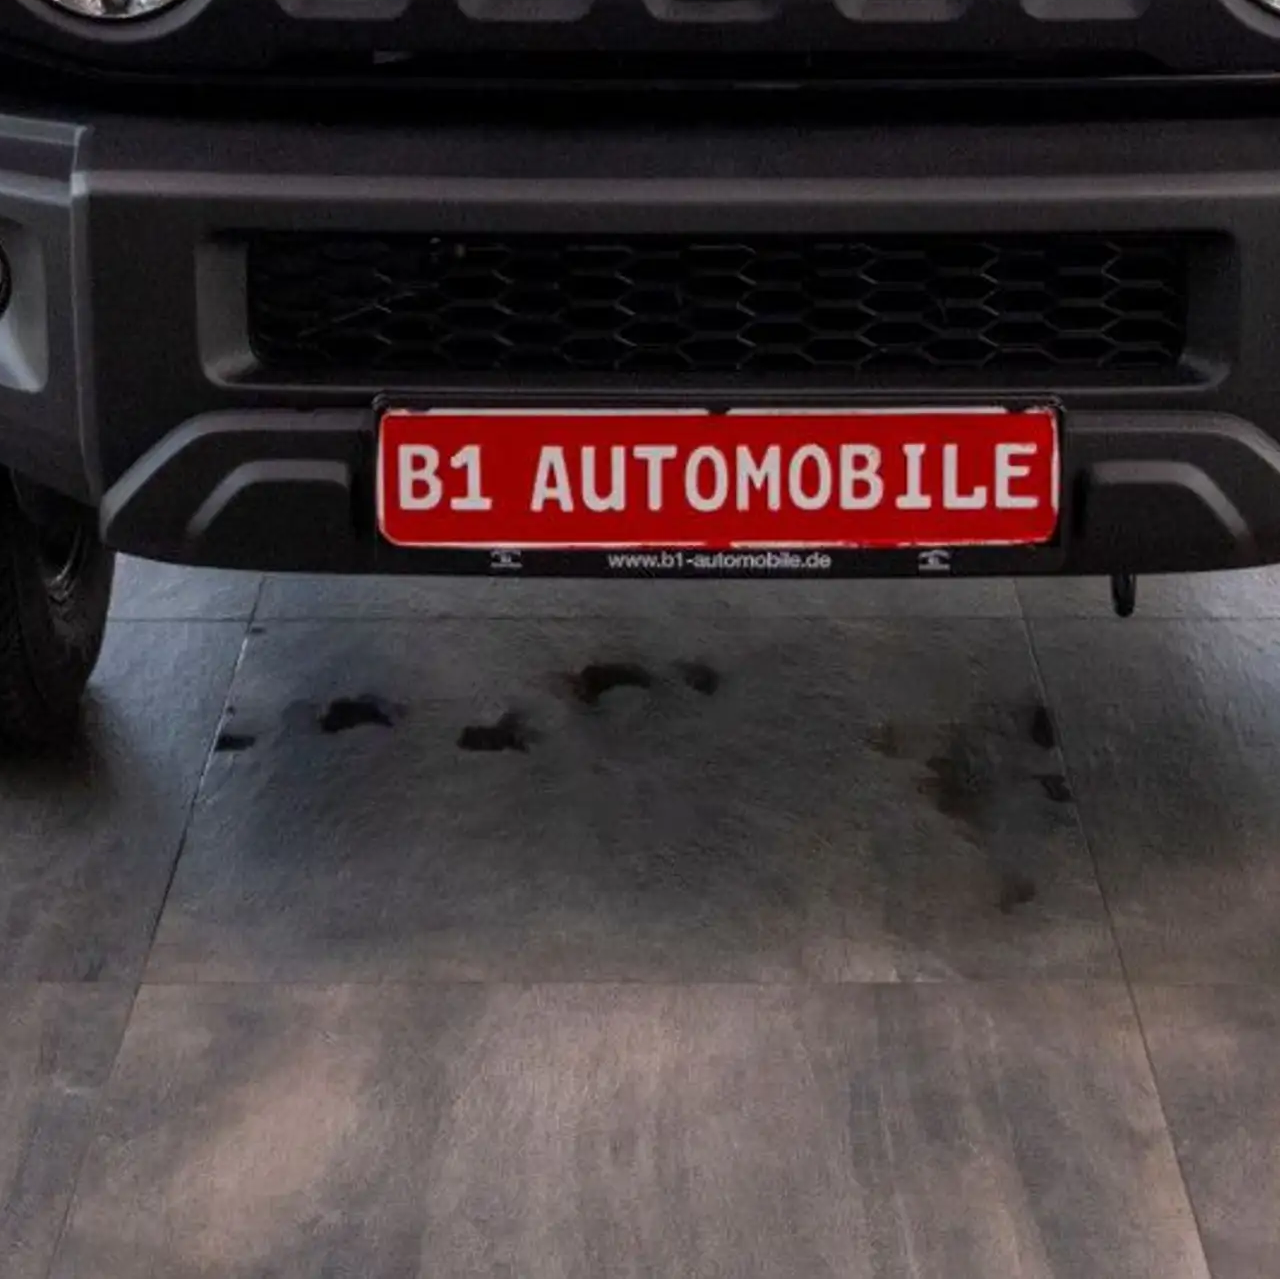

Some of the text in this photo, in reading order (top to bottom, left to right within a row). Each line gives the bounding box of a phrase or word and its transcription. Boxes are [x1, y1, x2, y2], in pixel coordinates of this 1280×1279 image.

[397, 442, 1040, 513] B1 AUTOMOBILE
[607, 551, 832, 569] www.b1-automobile.de
